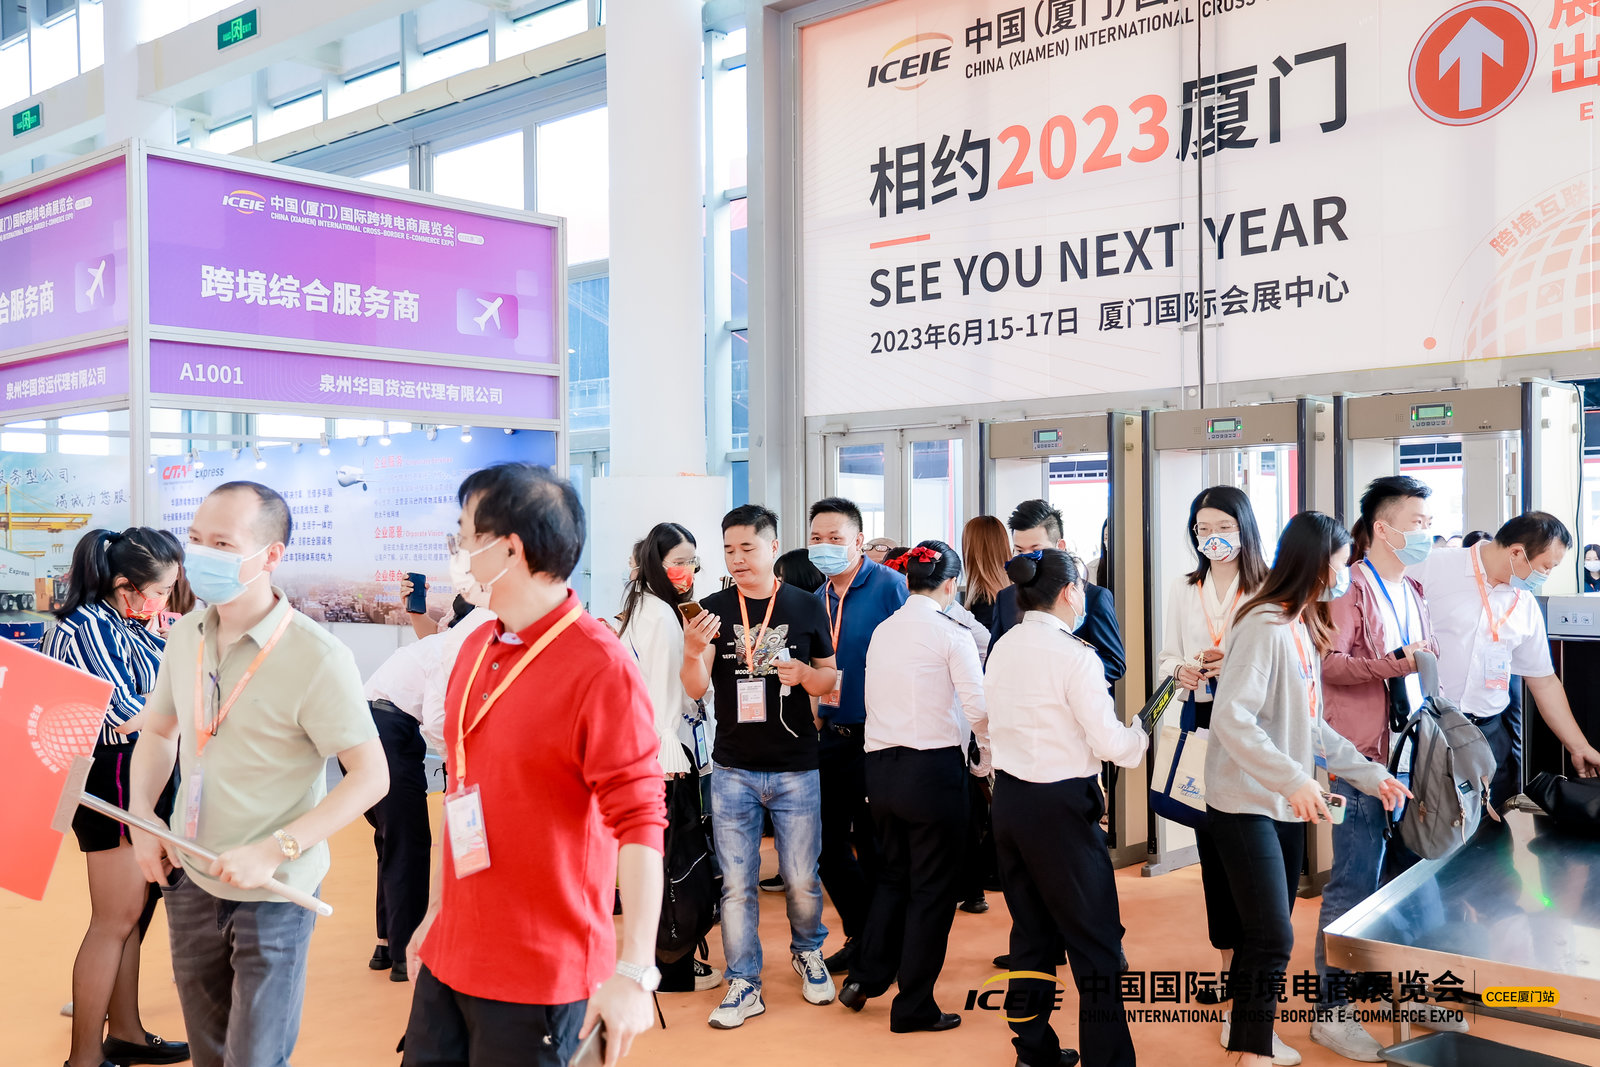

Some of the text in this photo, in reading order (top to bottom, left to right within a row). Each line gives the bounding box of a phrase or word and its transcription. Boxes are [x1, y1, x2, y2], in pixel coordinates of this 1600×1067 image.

[965, 56, 1005, 79] CHINA
[1009, 38, 1070, 70] (XIAMEN)
[1075, 7, 1194, 51] INTERNATIONAL
[867, 46, 952, 88] ICEIE
[870, 42, 1348, 218] 相约2023厦门
[222, 195, 265, 212] ICEIE
[270, 212, 290, 222] CHINA
[317, 219, 362, 233] INTERNATIONAL
[870, 195, 1350, 307] SEE YOU NEXT YEAR
[200, 264, 420, 323] 跨境综合服务商
[870, 272, 1350, 354] 2023年6月15-17日 厦门国际会展中心
[6, 366, 107, 400] 泉州华国货运代理有限公司
[179, 363, 244, 385] A1001
[319, 374, 503, 405] 泉州华国货运代理有限公司
